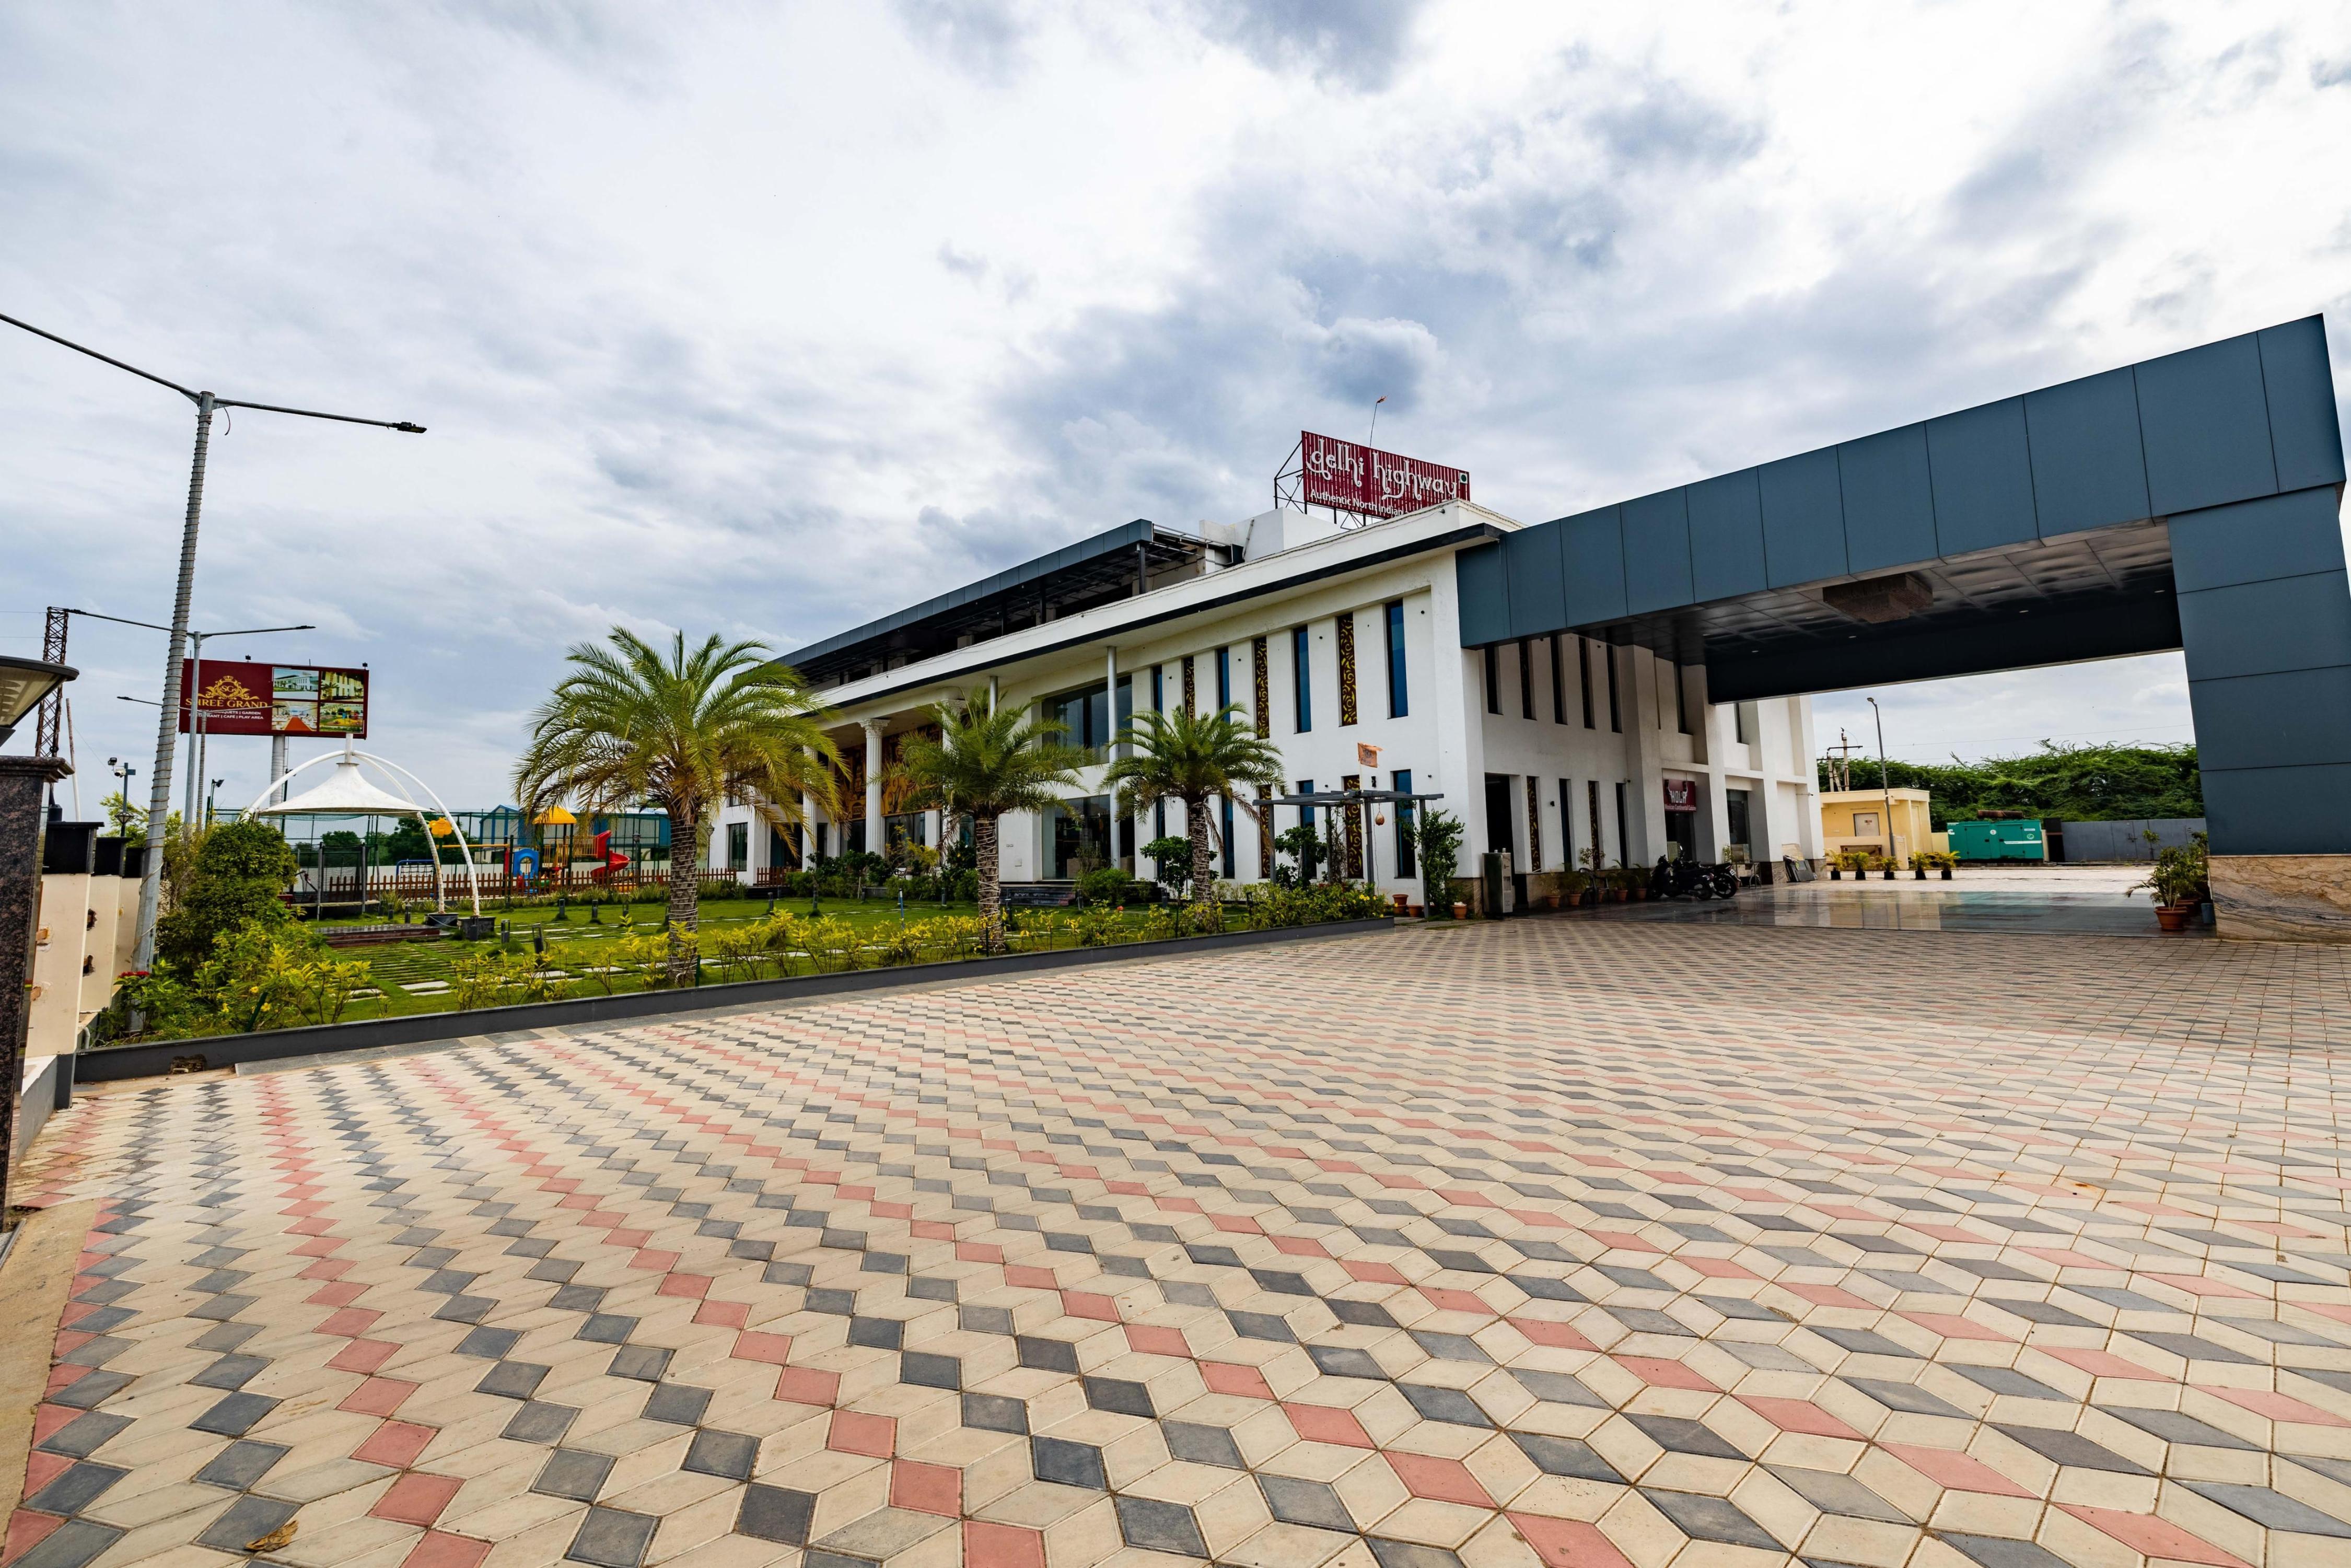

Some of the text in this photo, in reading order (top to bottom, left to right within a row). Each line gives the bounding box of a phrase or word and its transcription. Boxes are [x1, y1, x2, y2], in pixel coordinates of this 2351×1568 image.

[1306, 438, 1457, 500] delhi highway
[1310, 489, 1403, 516] Authentic North Indian
[1670, 791, 1687, 804] HOLA
